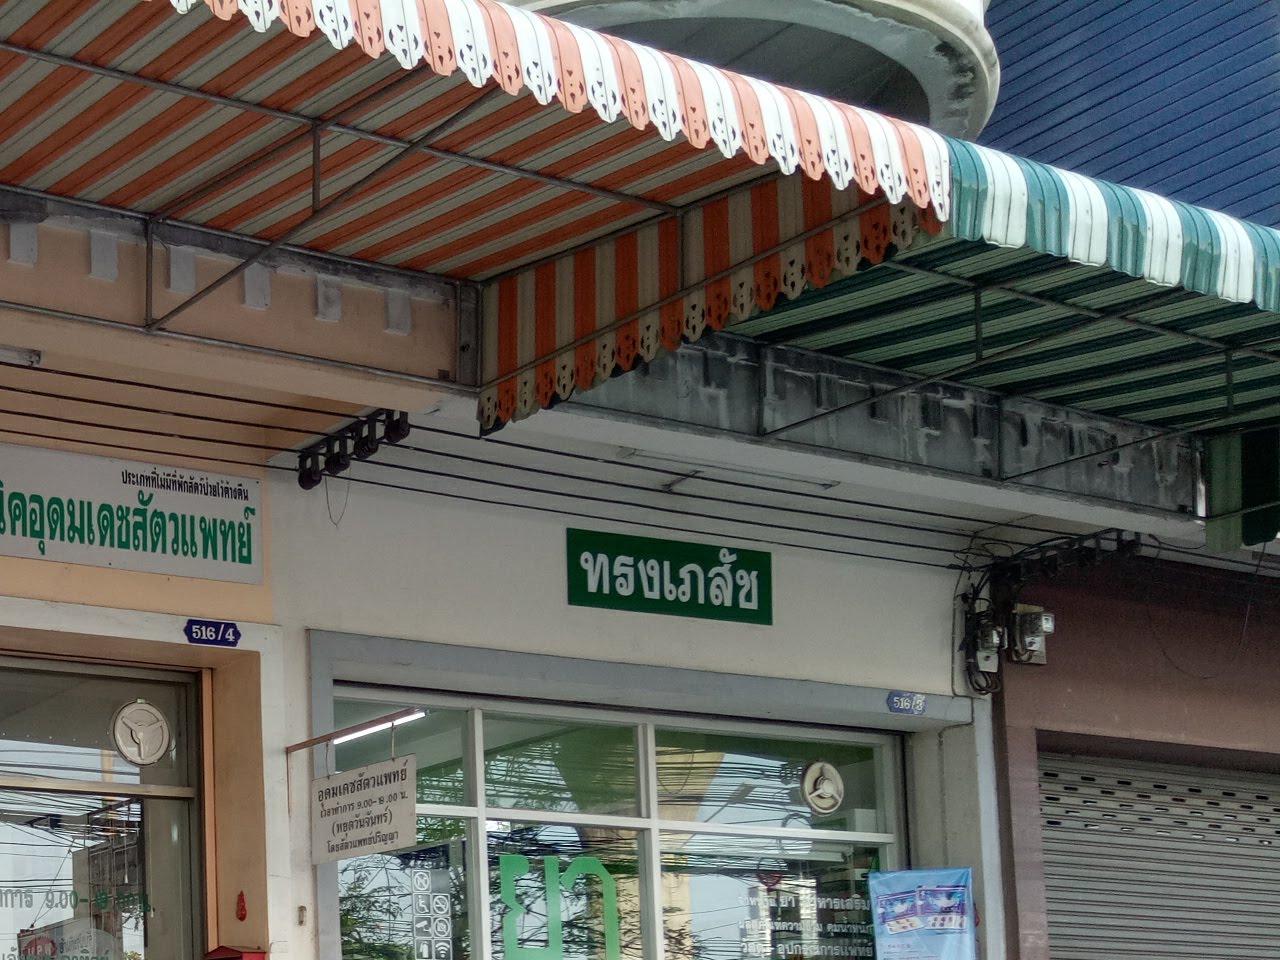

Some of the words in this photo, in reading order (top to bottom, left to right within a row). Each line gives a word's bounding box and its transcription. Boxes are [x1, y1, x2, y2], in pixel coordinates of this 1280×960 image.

[579, 547, 759, 610] ทรงเภสัช
[191, 623, 236, 642] 516/4
